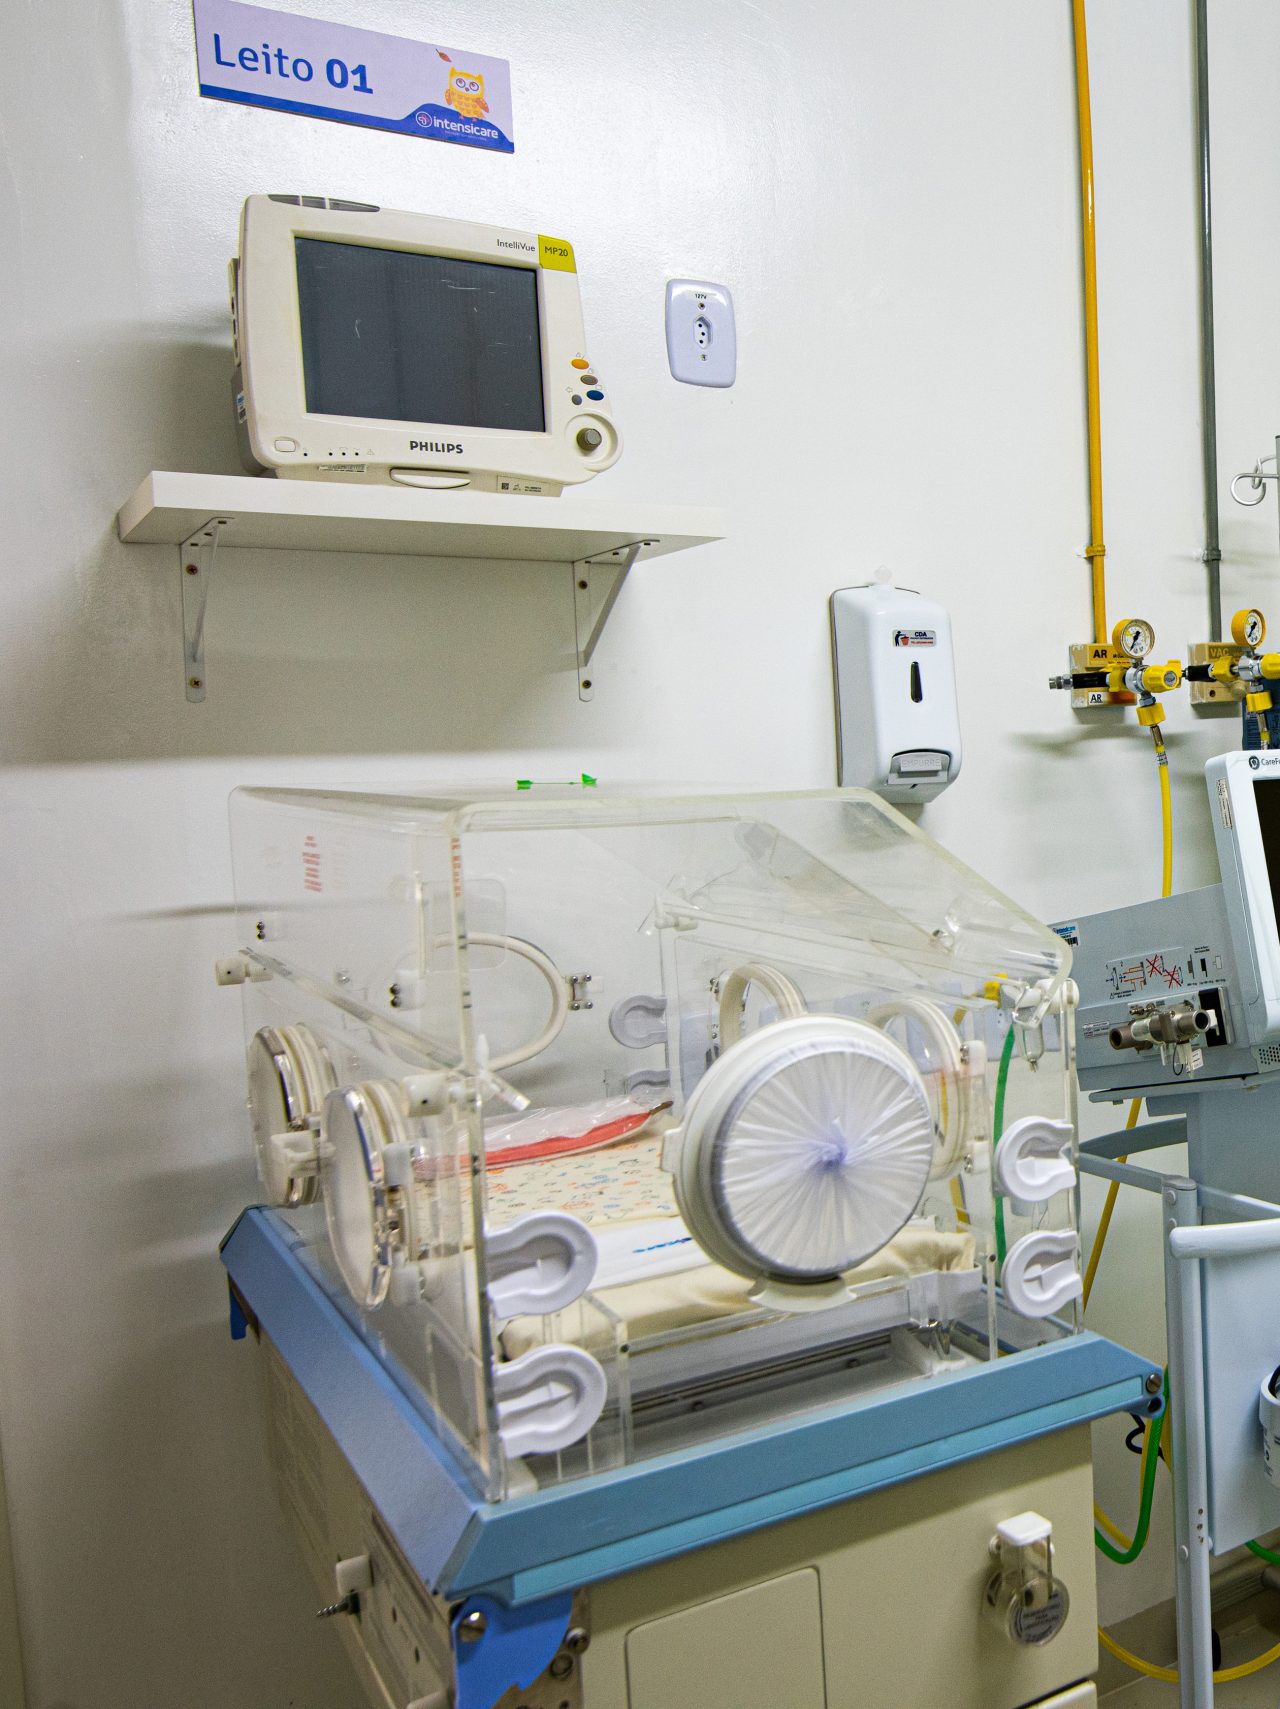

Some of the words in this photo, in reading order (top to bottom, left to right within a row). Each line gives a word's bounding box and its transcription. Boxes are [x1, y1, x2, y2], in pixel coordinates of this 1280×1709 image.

[213, 33, 314, 82] Leito
[326, 58, 374, 94] 01
[433, 116, 499, 139] intensicare
[497, 238, 536, 252] IntelliVue
[544, 246, 569, 257] MP20
[409, 440, 464, 454] PHILIPS
[1093, 649, 1107, 658] AR
[1210, 648, 1229, 657] VAC
